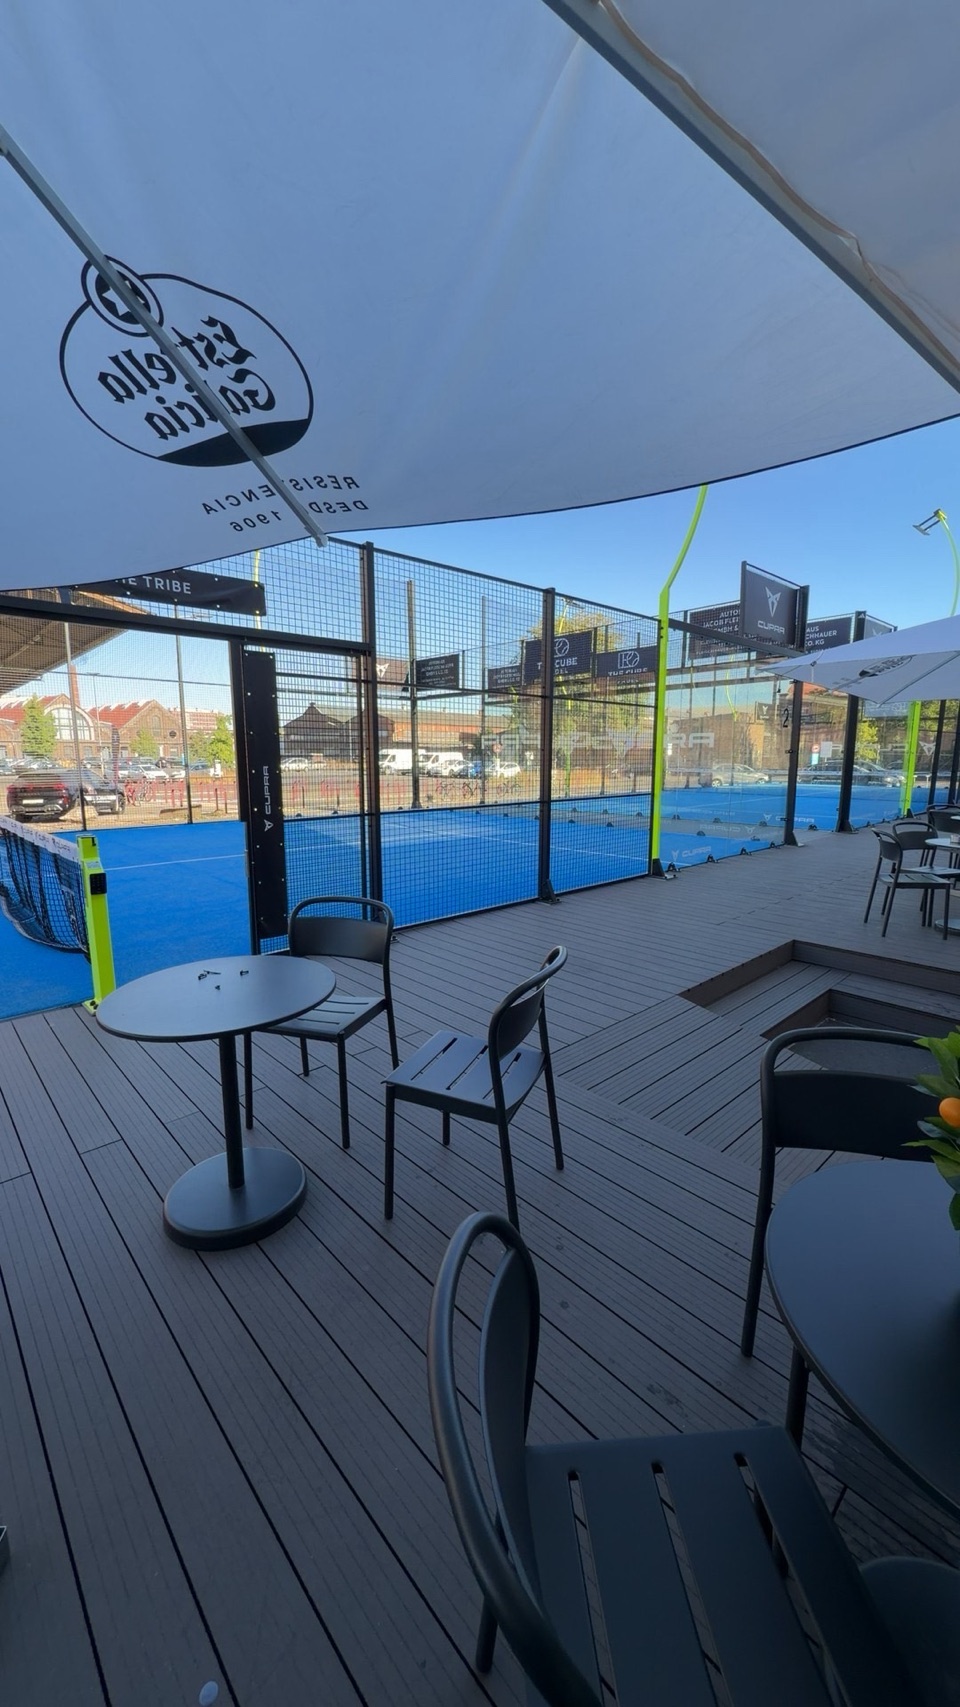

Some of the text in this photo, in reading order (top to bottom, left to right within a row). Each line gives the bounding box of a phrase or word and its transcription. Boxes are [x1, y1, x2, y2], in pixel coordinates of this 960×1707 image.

[142, 575, 192, 594] TRIBE
[757, 620, 785, 635] CUPRA
[554, 656, 578, 667] CUBE
[782, 707, 790, 728] 2
[263, 765, 271, 815] CUPRA
[681, 845, 712, 858] CUPRA
